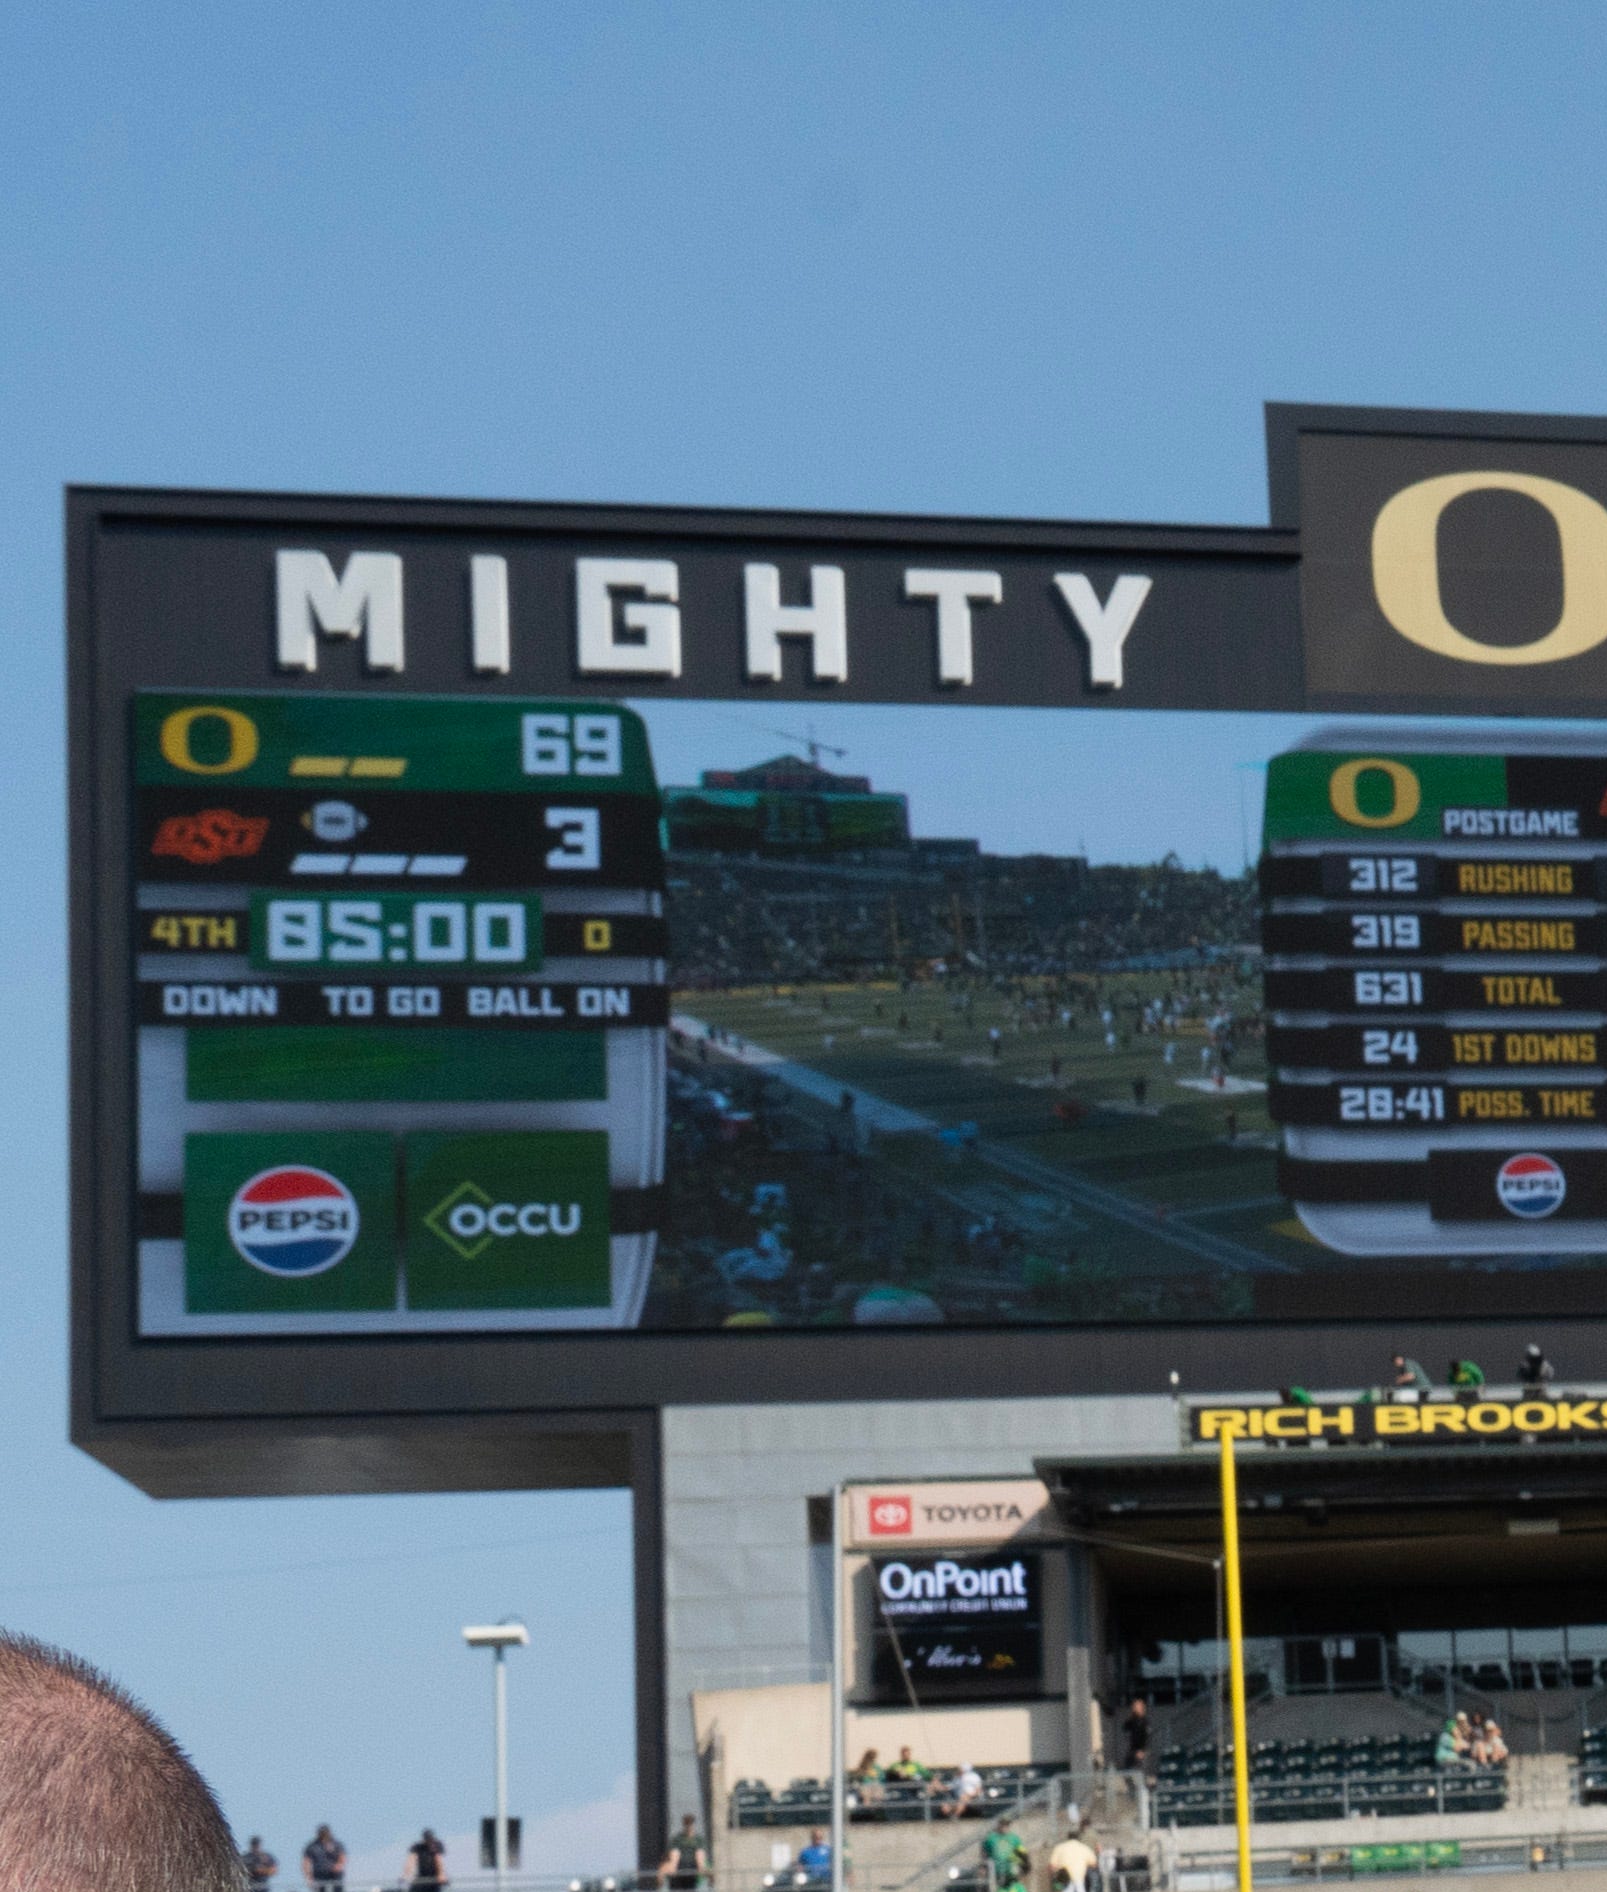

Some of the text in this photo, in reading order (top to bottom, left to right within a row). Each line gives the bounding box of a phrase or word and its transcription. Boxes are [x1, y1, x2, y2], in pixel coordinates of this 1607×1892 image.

[275, 549, 1152, 690] MIGHTY
[521, 713, 623, 777] 69
[545, 807, 601, 871] 3
[1443, 808, 1581, 837] POSTGAME
[1348, 858, 1418, 893] 312
[1457, 863, 1574, 896] RUSHING
[150, 917, 237, 949] 4TH
[1351, 914, 1421, 950] 319
[1462, 921, 1577, 953] PASSING
[162, 985, 631, 1018] DOWN TO GO BALL ON
[1355, 972, 1423, 1006] 631
[1481, 976, 1562, 1007] TOTAL
[1362, 1030, 1419, 1065] 24
[1451, 1033, 1497, 1063] 1ST
[1504, 1033, 1598, 1064] DOWNS
[1339, 1086, 1446, 1121] 28:41
[1457, 1091, 1531, 1119] POSS.
[1537, 1090, 1596, 1118] TIME
[1502, 1177, 1560, 1193] PEPSI
[238, 1209, 349, 1234] PEPSI
[448, 1202, 582, 1237] OCCU
[1199, 1405, 1355, 1440] RICH
[922, 1502, 1023, 1522] TOYOTA
[879, 1560, 1028, 1600] OnPoint
